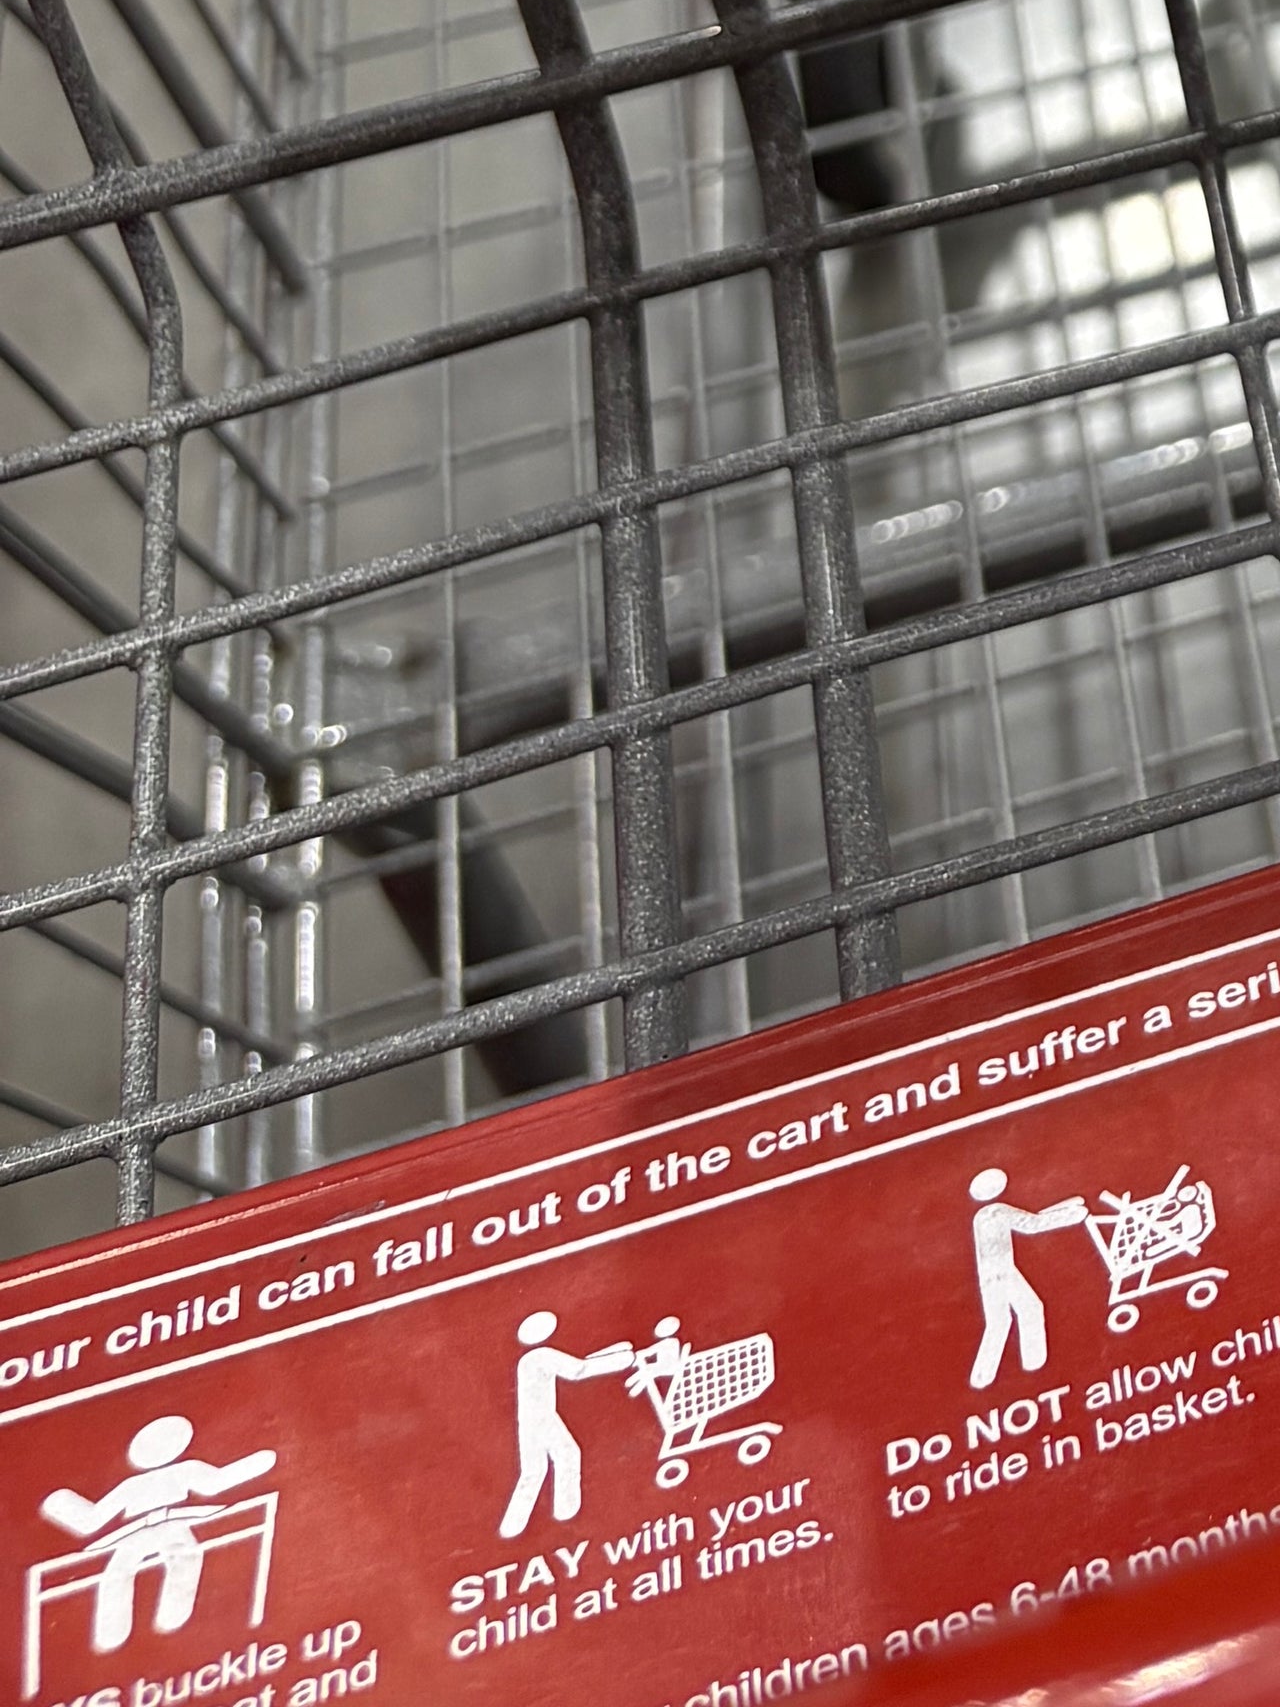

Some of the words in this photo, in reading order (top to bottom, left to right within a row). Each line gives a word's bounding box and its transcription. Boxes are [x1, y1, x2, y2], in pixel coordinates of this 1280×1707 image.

[105, 1291, 240, 1355] child
[258, 1258, 355, 1312] can
[372, 1222, 453, 1277] fall
[471, 1191, 562, 1246] out
[576, 1166, 632, 1215] of
[646, 1145, 731, 1193] the
[747, 1104, 849, 1160] cart
[863, 1063, 961, 1123] and
[978, 1016, 1127, 1086] suffer
[1143, 1005, 1173, 1033] a
[885, 1432, 952, 1476] Do
[966, 1385, 1070, 1449] NOT
[1085, 1350, 1197, 1410] allow
[888, 1483, 931, 1518] to
[946, 1451, 1028, 1502] ride
[1041, 1432, 1081, 1469] in
[1096, 1375, 1256, 1451] basket.
[449, 1593, 558, 1659] child
[573, 1578, 619, 1620] at
[631, 1555, 682, 1602] all
[697, 1519, 834, 1581] times.
[450, 1539, 589, 1615] STAY
[603, 1512, 695, 1566] with
[710, 1477, 810, 1540] your
[134, 1642, 288, 1707] buckle
[302, 1619, 362, 1662] up
[287, 1649, 378, 1707] and
[684, 1643, 868, 1707] children
